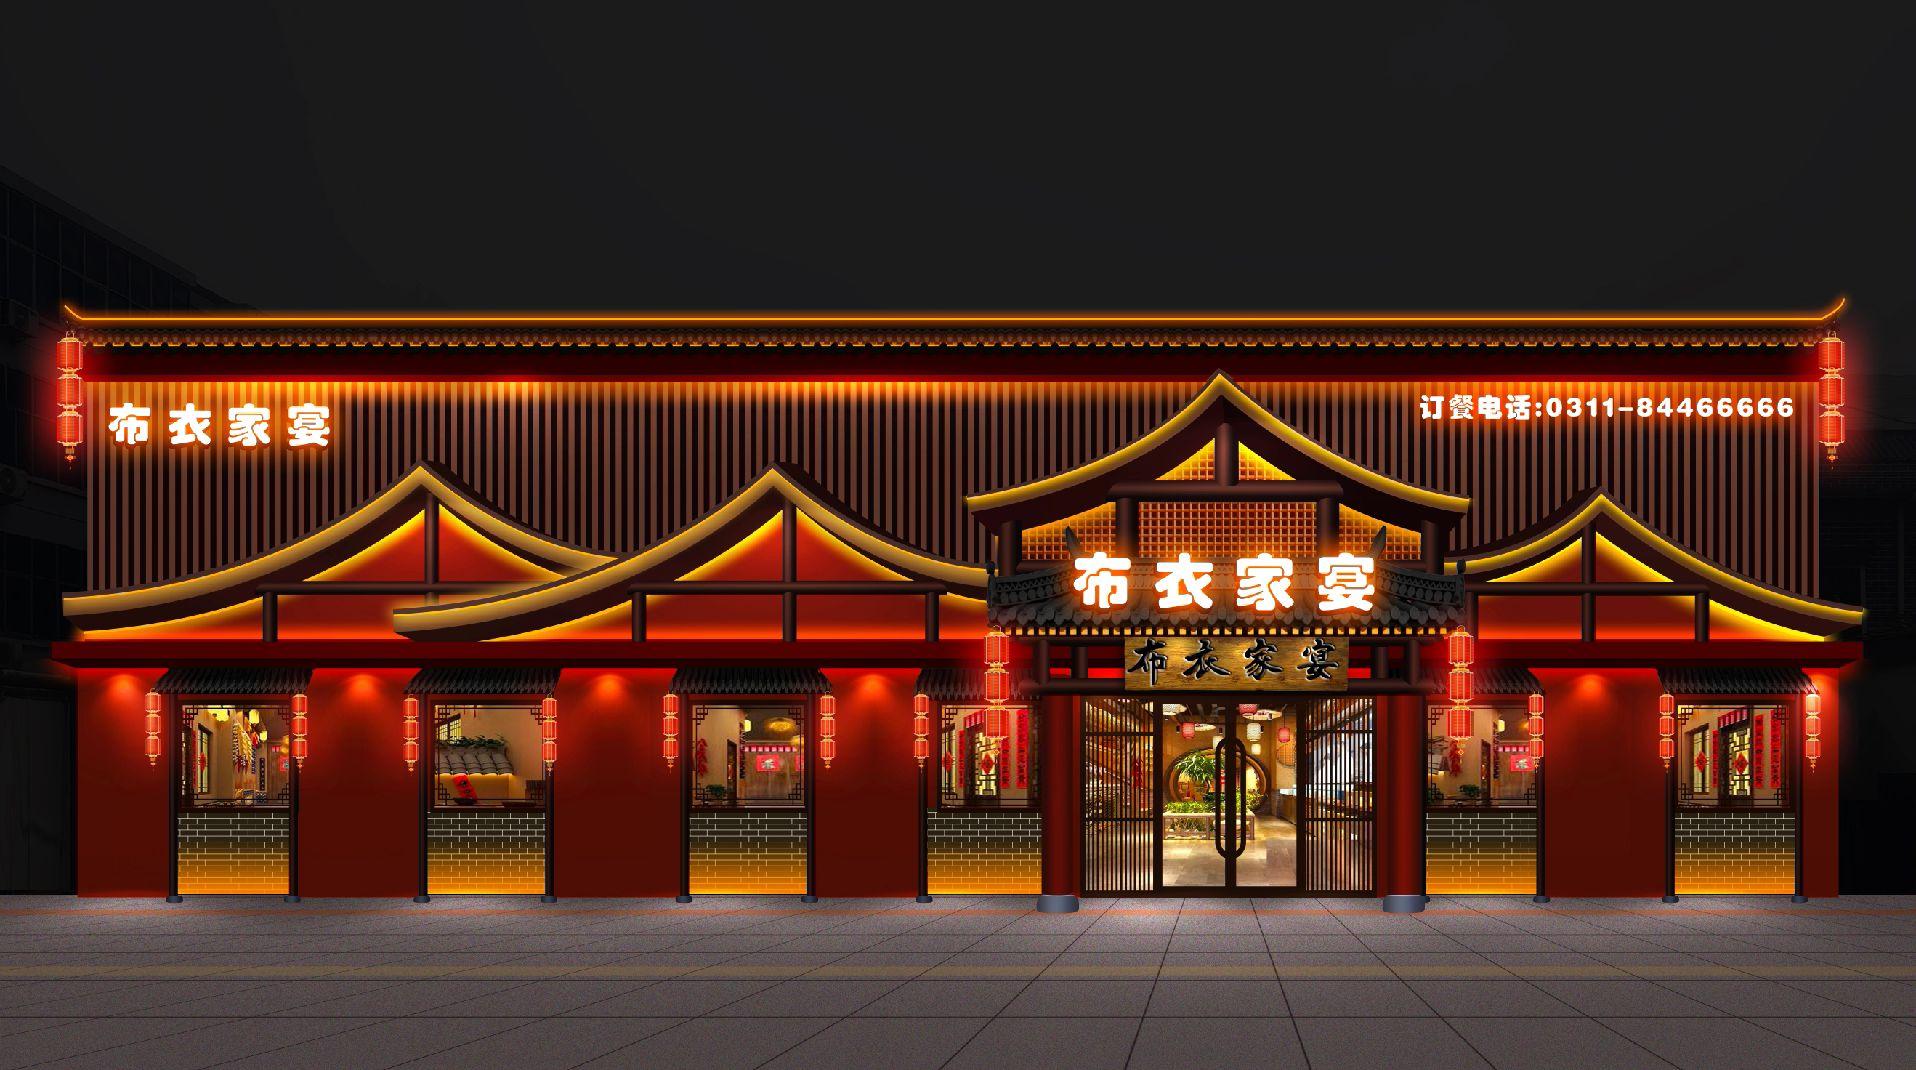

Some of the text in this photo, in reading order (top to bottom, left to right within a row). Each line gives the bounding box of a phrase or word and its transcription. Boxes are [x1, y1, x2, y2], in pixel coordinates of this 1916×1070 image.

[108, 402, 330, 446] 布衣家宴
[1073, 551, 1375, 612] 布衣家宴
[1127, 638, 1339, 687] 布衣家宴
